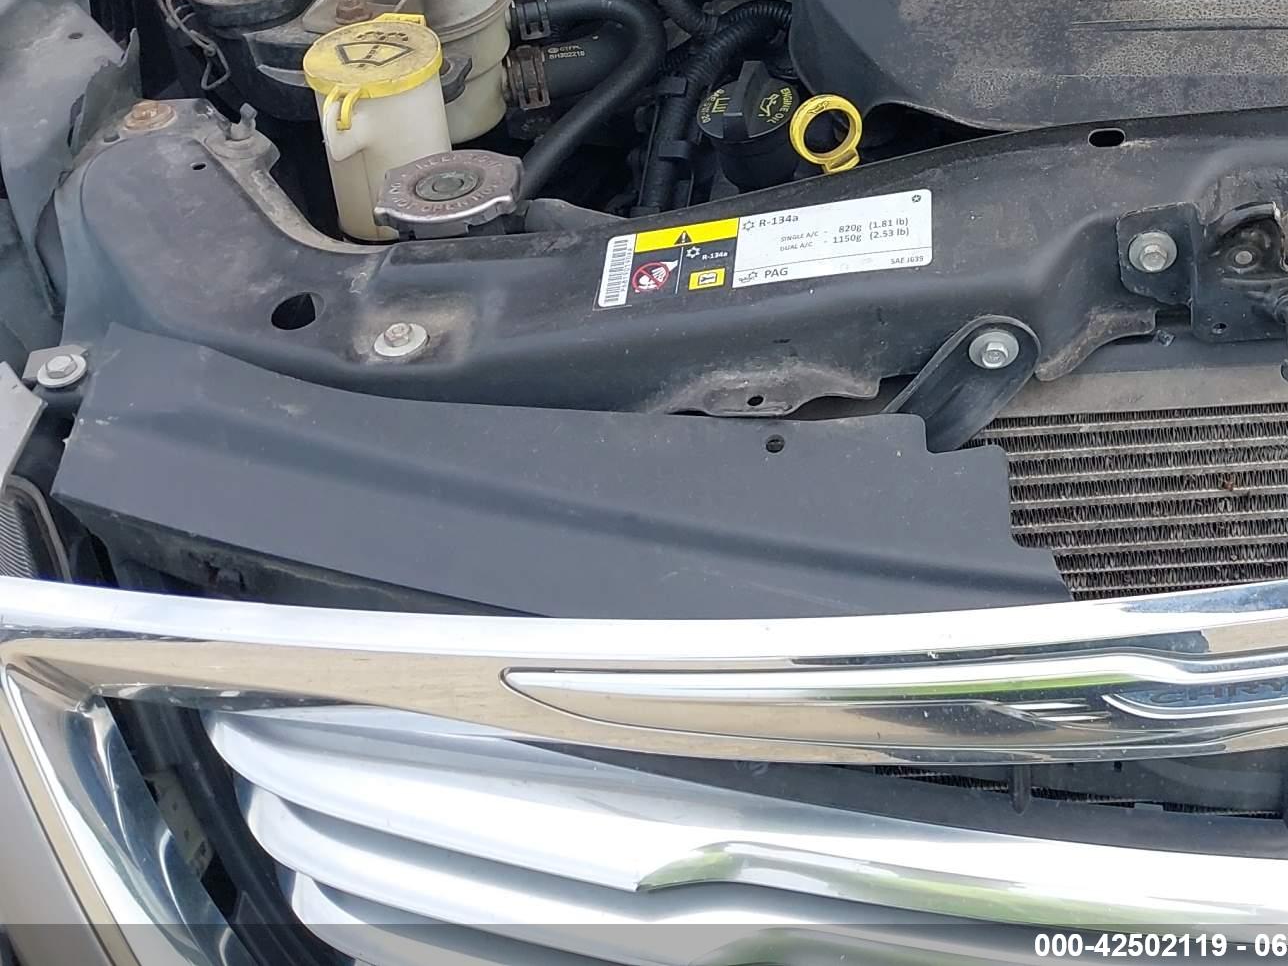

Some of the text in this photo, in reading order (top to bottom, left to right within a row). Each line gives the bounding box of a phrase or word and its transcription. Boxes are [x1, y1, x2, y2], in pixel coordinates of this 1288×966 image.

[766, 87, 793, 124] ENGINE OIL
[759, 214, 799, 228] R-134a
[781, 233, 805, 243] SINGLE
[806, 230, 819, 239] A/C
[838, 224, 862, 234] 820g
[869, 219, 893, 231] (1.81
[896, 217, 909, 228] lb)
[800, 241, 813, 250] A/C
[832, 233, 862, 245] 1150g
[869, 229, 894, 241] (2.53
[896, 226, 909, 236] lb)
[702, 250, 728, 261] R-134a
[764, 268, 788, 278] PAG
